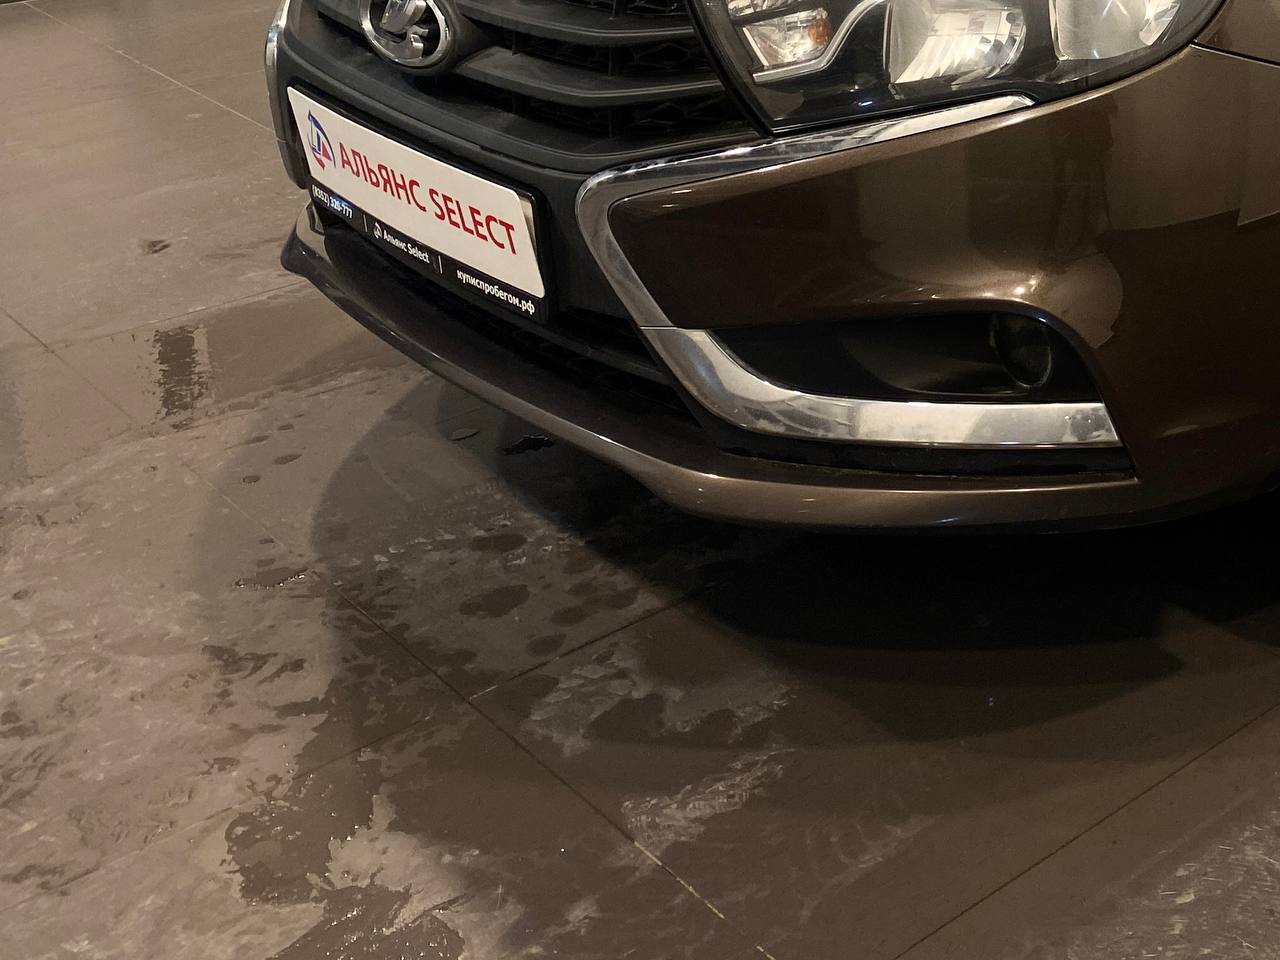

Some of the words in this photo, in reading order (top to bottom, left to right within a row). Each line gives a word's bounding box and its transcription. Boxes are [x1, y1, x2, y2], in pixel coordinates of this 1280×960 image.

[339, 142, 427, 213] АЛЬЯНС
[428, 188, 517, 255] SELECT
[383, 229, 407, 252] Альянс
[407, 243, 430, 264] Select
[456, 269, 536, 315] куписпробегом.рф
